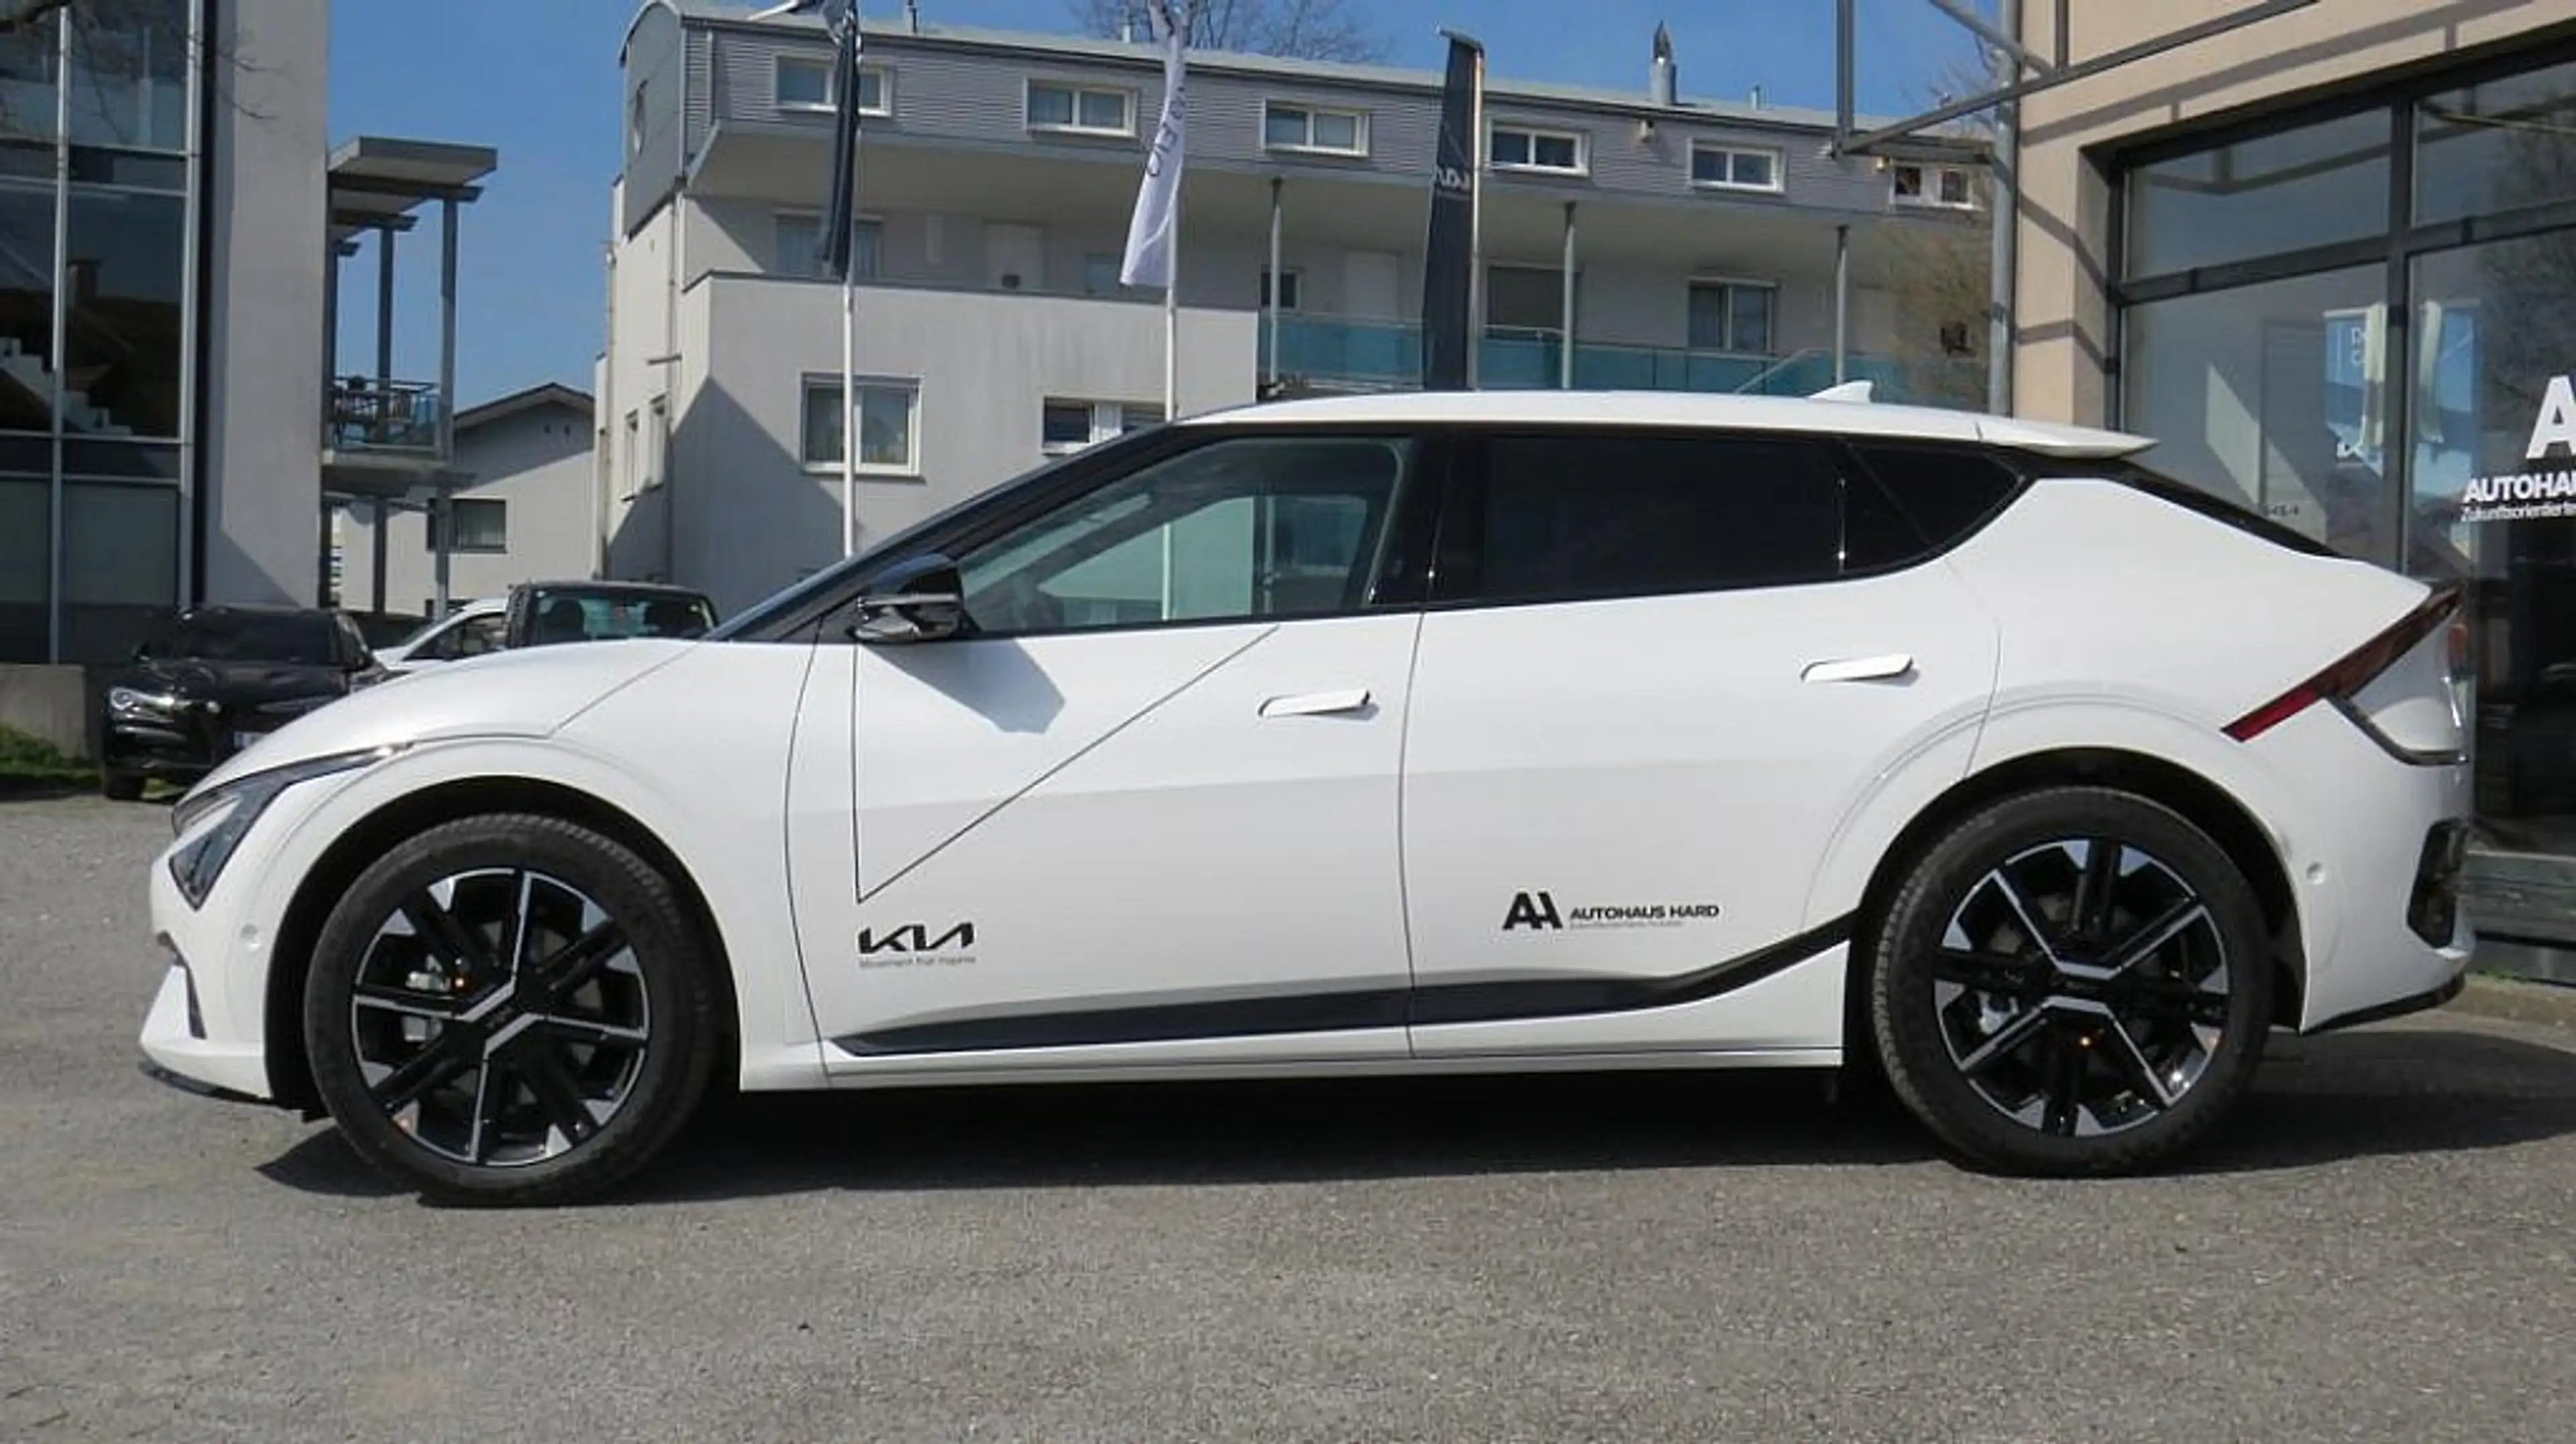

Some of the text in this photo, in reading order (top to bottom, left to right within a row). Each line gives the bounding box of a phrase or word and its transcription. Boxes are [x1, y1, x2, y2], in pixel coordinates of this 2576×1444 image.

[1570, 905, 1719, 919] AUTOHAUS HARD
[858, 922, 975, 953] KIA
